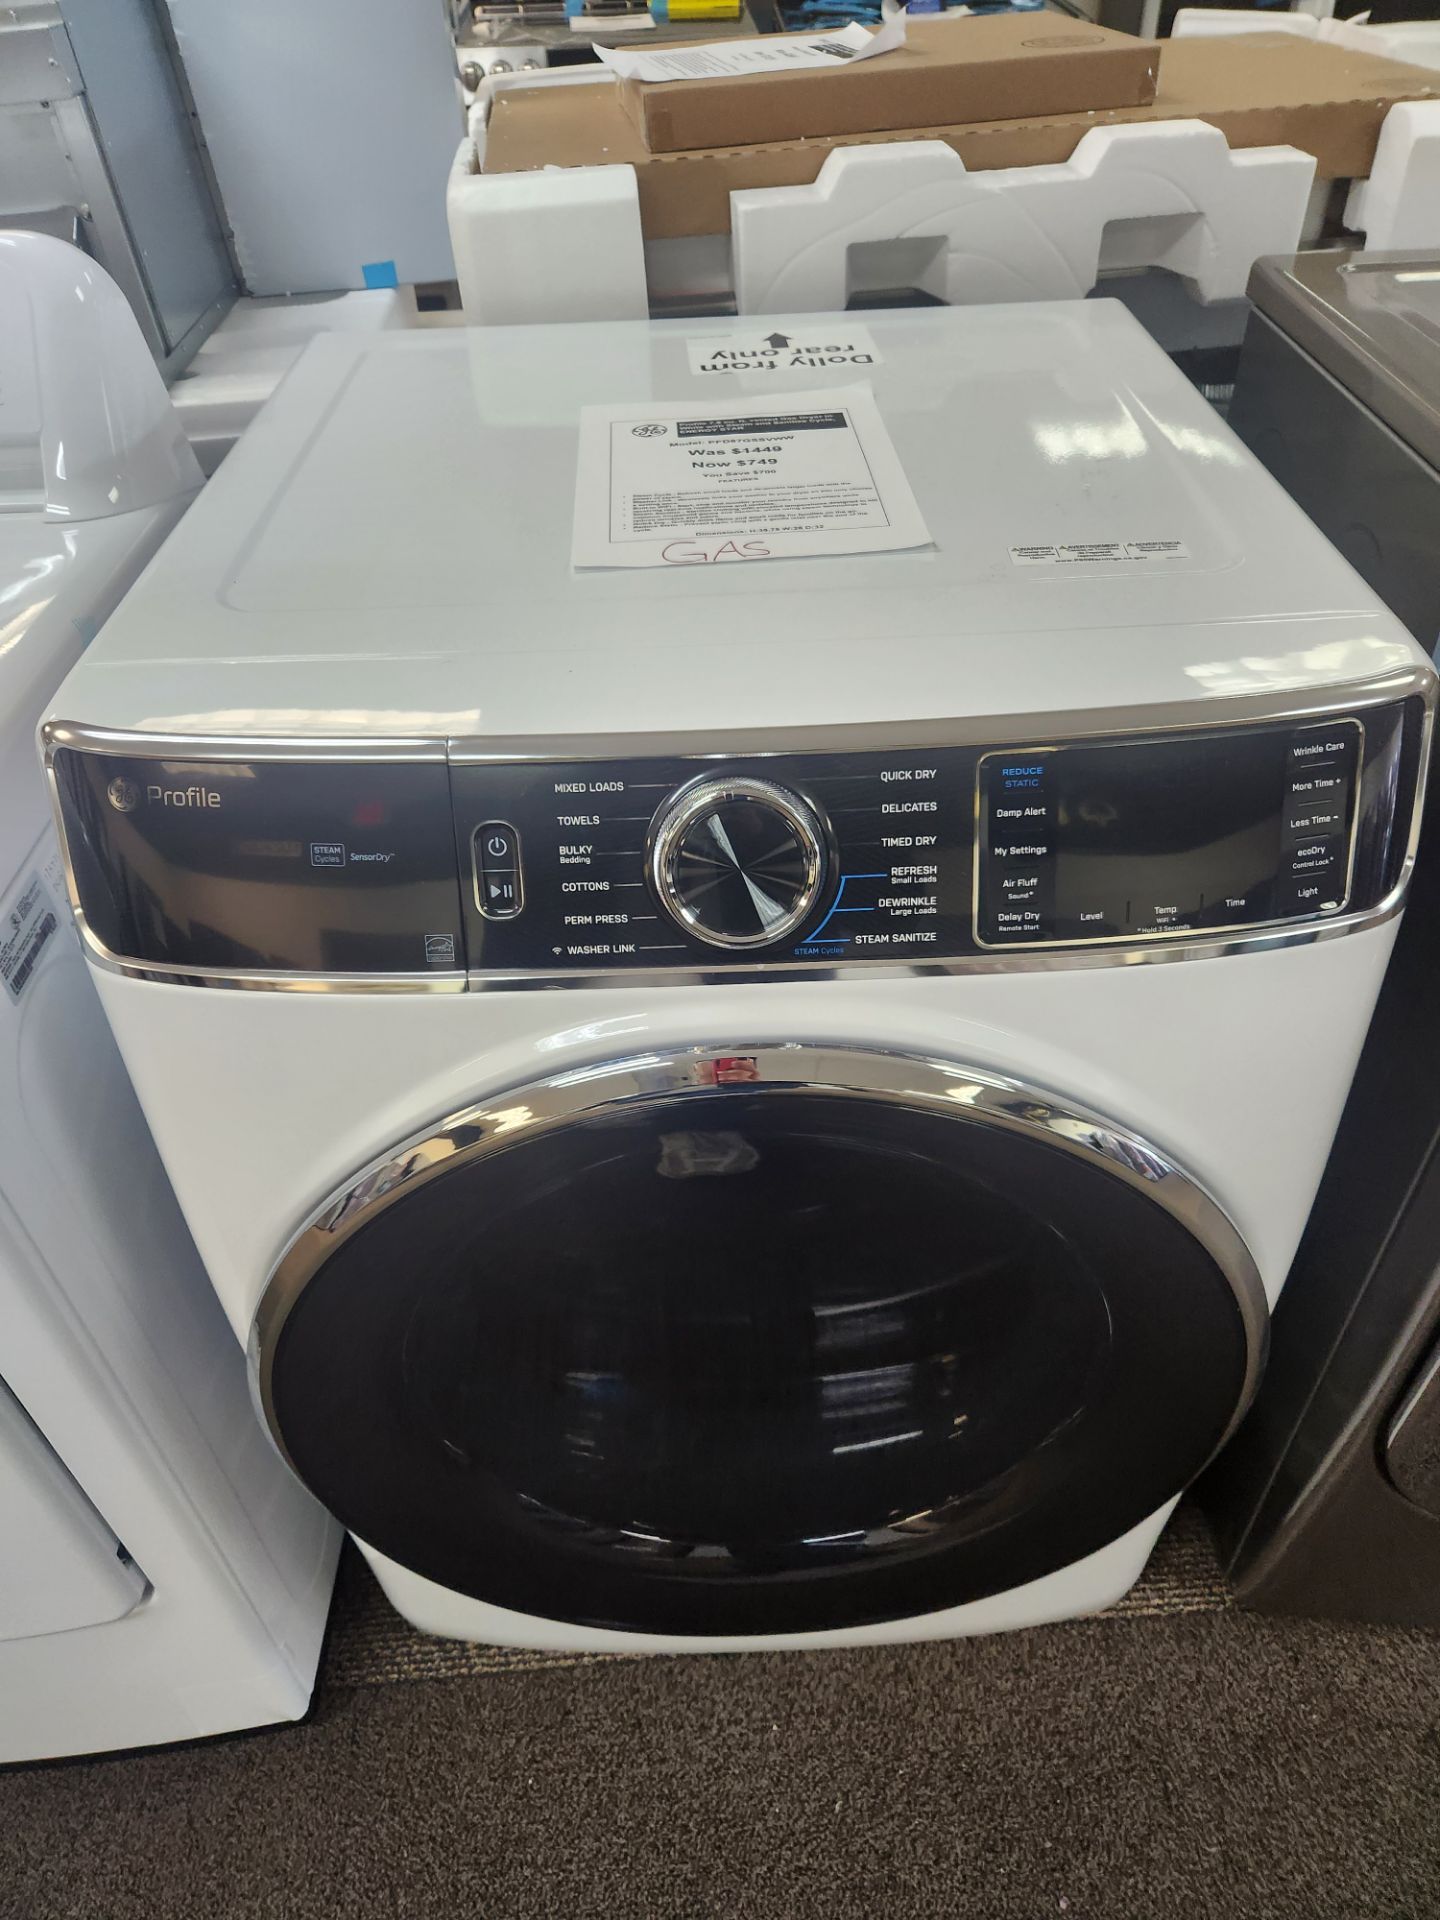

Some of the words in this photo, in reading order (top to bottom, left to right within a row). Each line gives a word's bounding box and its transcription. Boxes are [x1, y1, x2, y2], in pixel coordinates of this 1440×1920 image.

[711, 349, 779, 360] only
[791, 344, 855, 355] rear
[790, 354, 874, 367] Dolly
[700, 360, 777, 372] from
[730, 446, 783, 455] $1449
[736, 458, 778, 466] $749
[661, 540, 771, 563] GAS
[1293, 745, 1323, 756] Wrinkle
[1326, 742, 1345, 751] Care
[880, 770, 913, 781] QUICK
[915, 769, 937, 780] DRY
[554, 783, 586, 793] MIXED
[589, 782, 624, 792] LOADS
[1005, 779, 1039, 787] STATIC
[1292, 782, 1312, 791] More
[1315, 779, 1334, 787] Time
[147, 786, 221, 807] Profile
[881, 802, 937, 813] DELICATES
[996, 809, 1022, 817] Damp
[1024, 807, 1046, 815] Alert
[557, 815, 600, 826] TOWELS
[1290, 819, 1310, 828] Less
[1312, 816, 1331, 824] Time
[881, 837, 913, 847] TIMED
[915, 836, 937, 846] DRY
[559, 845, 593, 855] BULKY
[995, 848, 1007, 856] My
[1010, 846, 1047, 855] Settings
[1298, 846, 1325, 856] ecoDry
[315, 855, 340, 863] Cycles
[560, 855, 591, 864] Bedding
[891, 865, 937, 875] REFRESH
[1292, 861, 1315, 869] Control
[891, 876, 912, 884] Small
[914, 875, 937, 883] Loads
[1017, 878, 1038, 886] Fluff
[561, 881, 610, 892] COTTONS
[1298, 887, 1319, 897] Light
[878, 896, 937, 907] DEWRINKLE
[1225, 899, 1245, 907] Time
[891, 907, 912, 916] Large
[914, 906, 937, 915] Loads
[1154, 906, 1177, 915] Temp
[564, 915, 593, 925] PERM
[596, 914, 628, 924] PRESS
[998, 913, 1022, 921] Delay
[1025, 912, 1040, 921] Dry
[1080, 912, 1103, 921] Level
[855, 934, 890, 944] STEAM
[891, 932, 937, 943] SANITIZE
[568, 944, 611, 955] WASHER
[613, 943, 635, 953] LINK
[794, 947, 819, 956] STEAM
